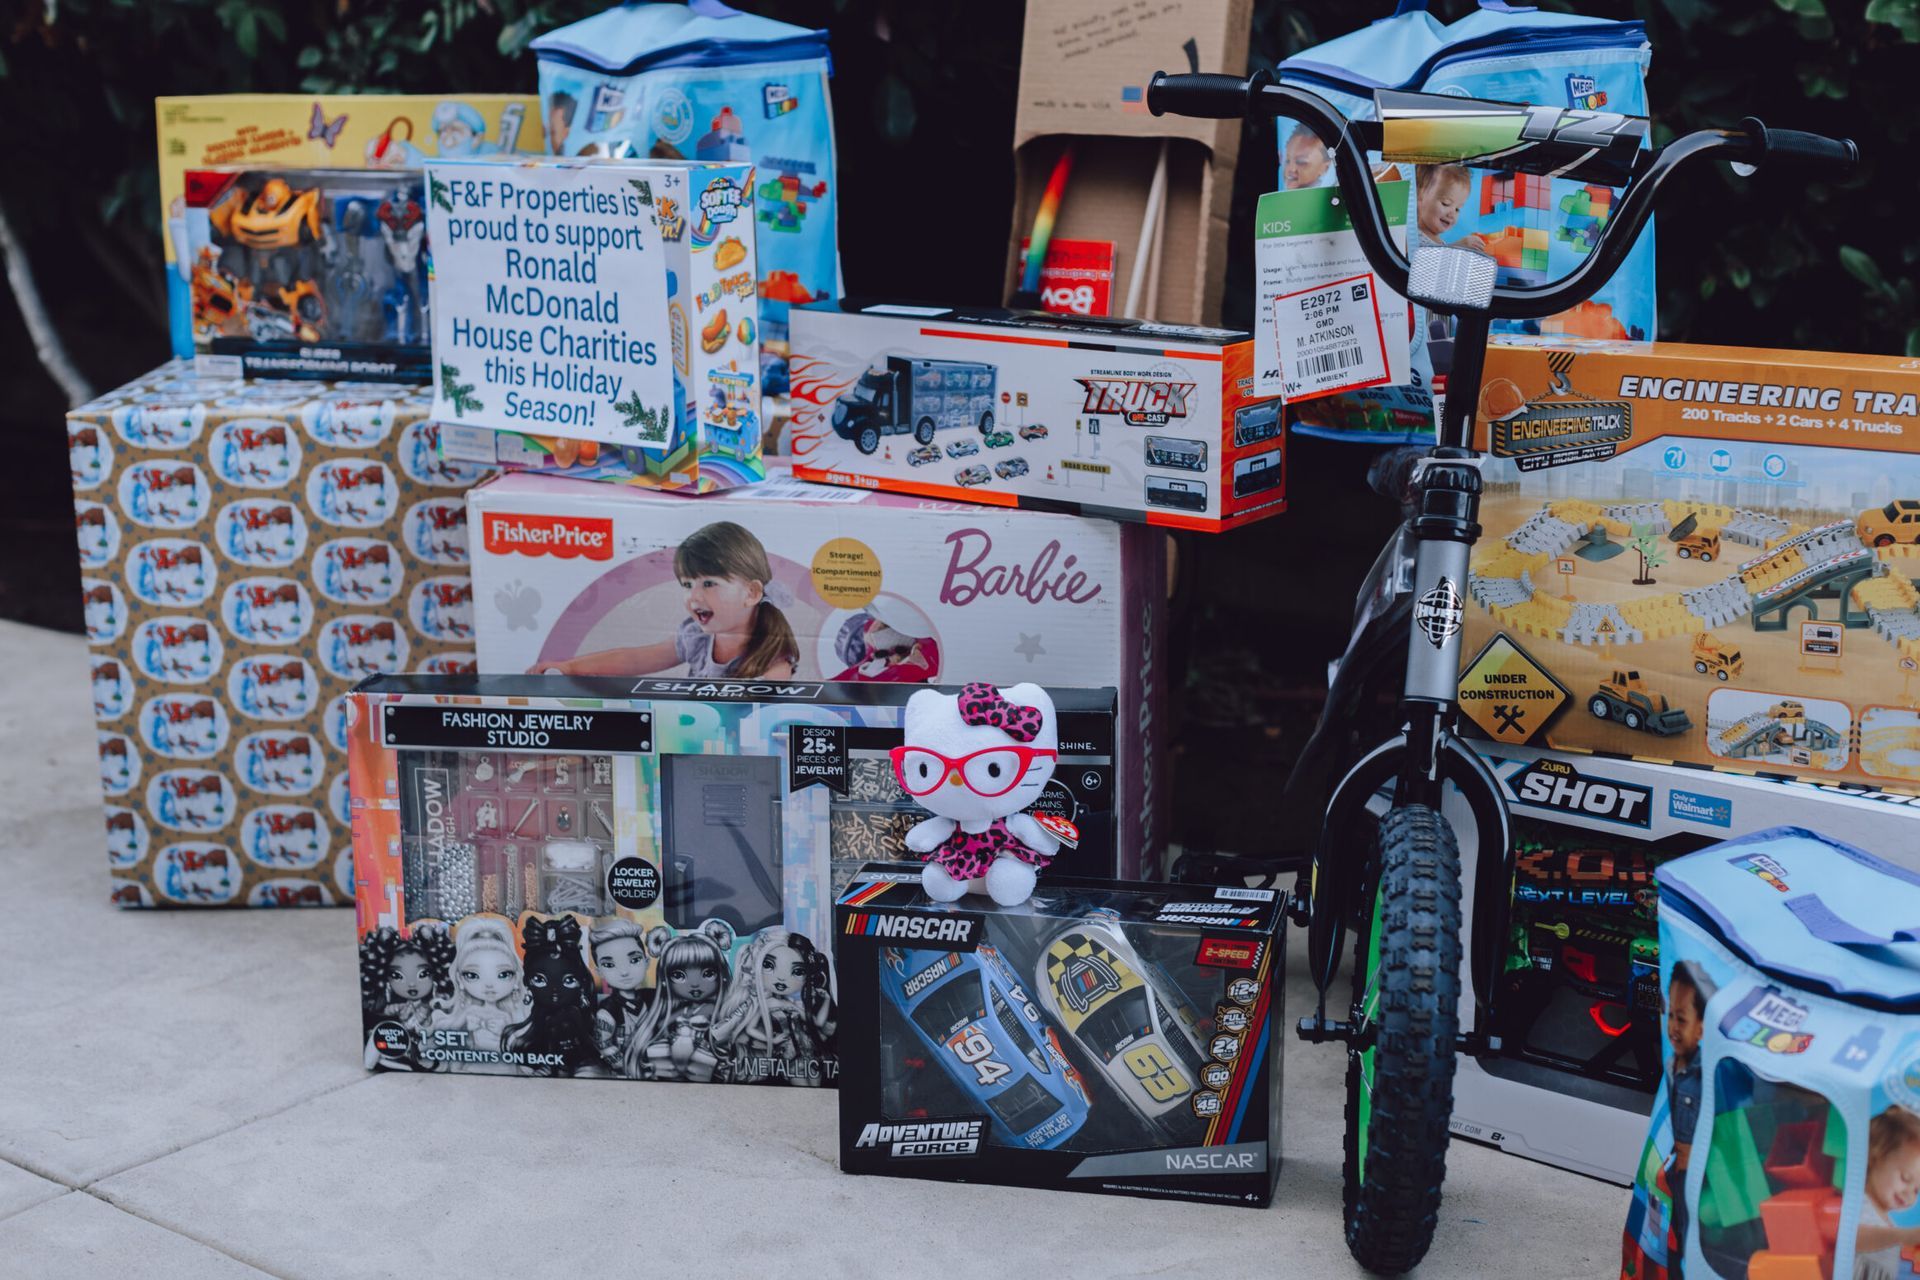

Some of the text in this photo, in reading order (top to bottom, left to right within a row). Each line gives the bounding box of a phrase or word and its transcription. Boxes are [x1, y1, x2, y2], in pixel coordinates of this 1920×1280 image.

[1573, 79, 1593, 94] MEGA
[1520, 106, 1624, 146] 12
[664, 174, 681, 188] 3+
[450, 180, 639, 219] F&F Properties is
[449, 215, 644, 255] proud to support
[1262, 220, 1292, 235] KIDS
[505, 248, 597, 284] Ronald
[1263, 266, 1282, 274] Usage:
[1263, 278, 1283, 286] Frame:
[486, 284, 619, 324] McDonald
[1301, 290, 1342, 311] E2972
[1305, 305, 1340, 321] 2:06 PM
[1316, 317, 1334, 329] GMD
[453, 317, 657, 366] House Charities
[1309, 325, 1354, 345] ATKINSON
[485, 357, 622, 403] this Holiday
[1091, 369, 1122, 377] STREAMLINE
[1316, 371, 1349, 384] AMBIENT
[1285, 382, 1302, 394] W+
[1619, 375, 1842, 411] ENGINEERING
[1080, 379, 1197, 417] TRUCK
[504, 391, 595, 427] Season!
[1511, 414, 1621, 441] ENGINEERING TRUCK
[1682, 407, 1903, 435] 200 Tracks + 2 Cars + 4 Trucks
[826, 470, 850, 484] ages
[829, 551, 863, 561] Storage!
[939, 528, 1102, 607] Barbie
[823, 584, 871, 593] Rangement!
[1484, 673, 1528, 685] UNDER
[651, 682, 806, 697] SHADOW
[1459, 688, 1555, 701] CONSTRUCTION
[443, 712, 593, 732] FASHION JEWELRY
[487, 730, 550, 746] STUDIO
[802, 728, 835, 737] DESIGN
[802, 737, 836, 754] 25+
[796, 754, 841, 764] PIECES OF
[795, 765, 843, 775] JEWELRY!
[1540, 760, 1571, 775] ZURU
[1085, 775, 1098, 786] 6+
[1519, 771, 1647, 819] SHOT
[1672, 792, 1697, 803] Only at
[1672, 800, 1714, 817] Walmart
[614, 867, 654, 877] LOCKER
[612, 878, 657, 888] JEWELRY
[613, 888, 656, 899] HOLDER!
[1568, 891, 1635, 906] LEVEL
[875, 914, 972, 943] NASCAR
[1205, 947, 1250, 960] 2-SPEED
[904, 958, 947, 998] NASCAR
[1230, 982, 1259, 996] 1:24
[1223, 1013, 1247, 1022] FULL
[378, 1028, 405, 1037] WATCH
[385, 1035, 398, 1043] ON
[419, 1030, 468, 1047] 1 SET
[1213, 1039, 1239, 1054] 2.4
[502, 1052, 525, 1065] ON
[527, 1053, 565, 1066] BACK
[953, 1033, 1013, 1087] 94
[744, 1057, 819, 1079] METALLIC
[1122, 1043, 1191, 1102] 63
[1208, 1070, 1230, 1082] 100
[1196, 1098, 1217, 1111] 45
[1055, 1113, 1068, 1124] UP
[855, 1121, 982, 1148] ADVENTURE
[899, 1141, 971, 1156] FORCE
[1165, 1153, 1254, 1169] NASCAR
[1244, 1192, 1259, 1202] 4+
